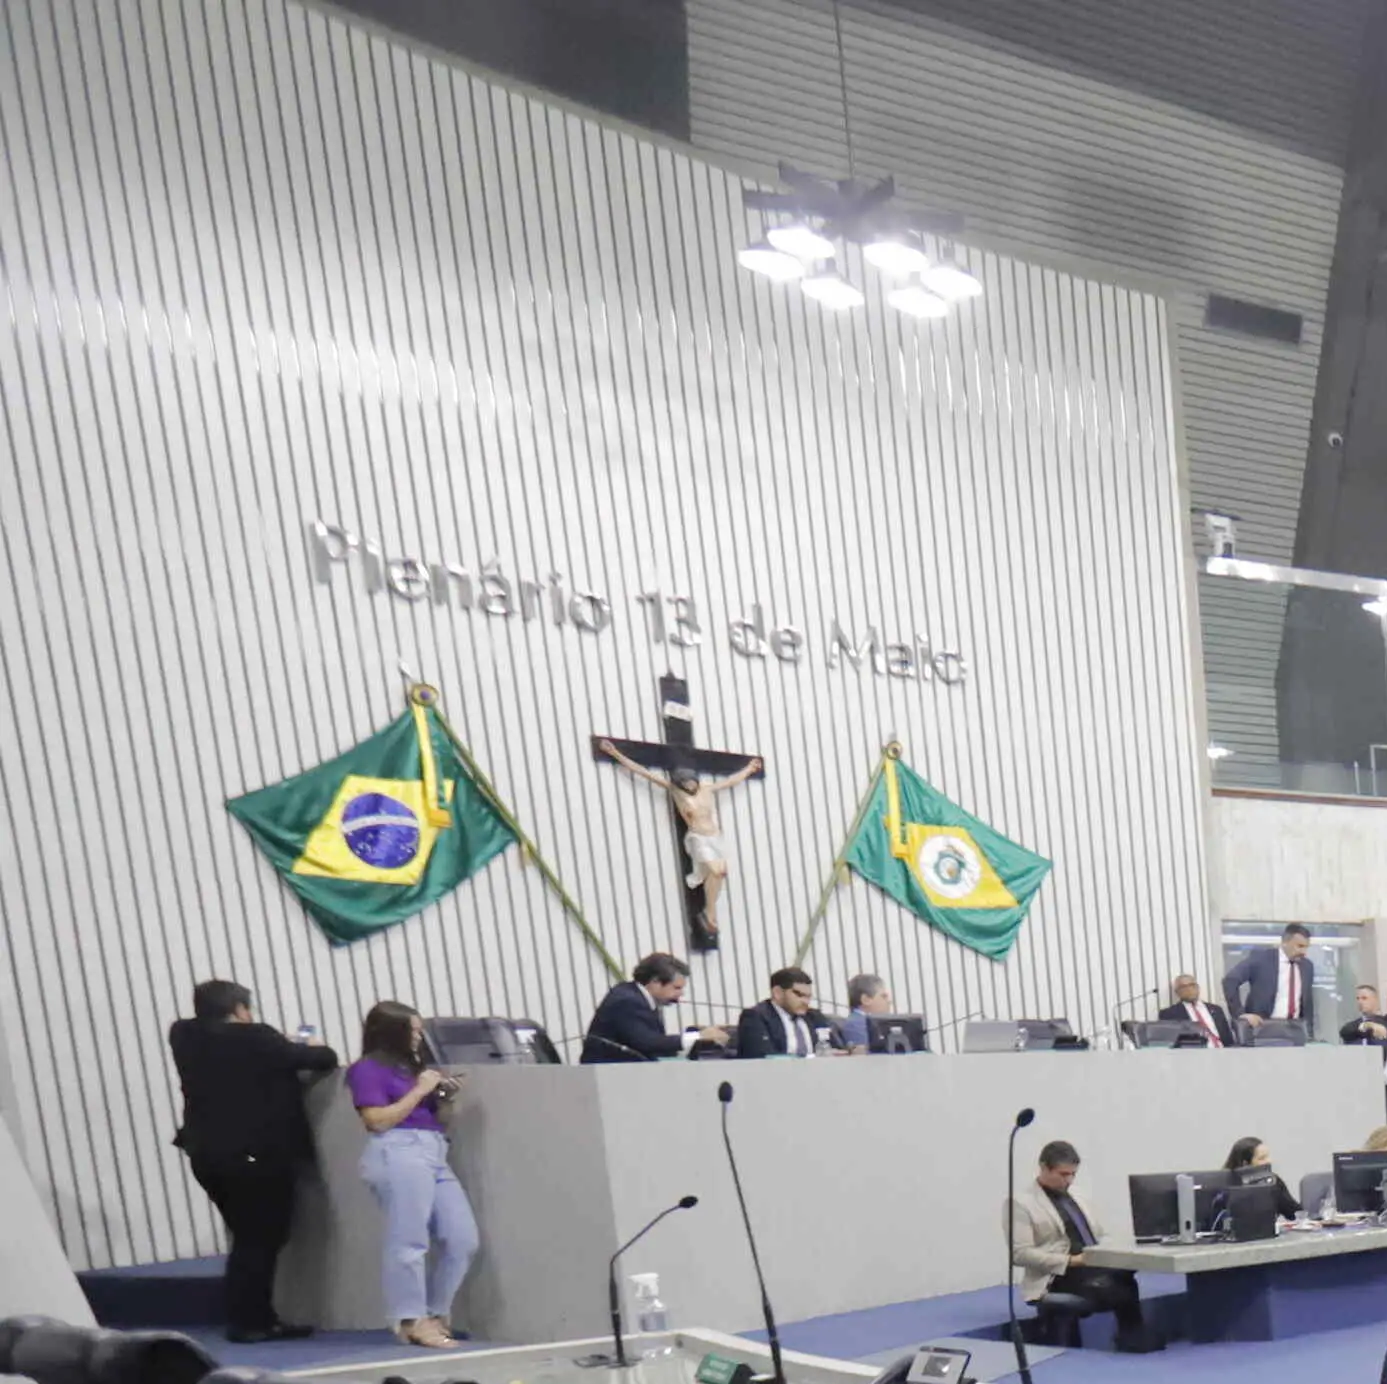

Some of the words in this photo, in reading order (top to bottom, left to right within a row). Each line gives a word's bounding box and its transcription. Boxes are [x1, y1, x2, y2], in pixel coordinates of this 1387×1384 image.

[310, 518, 611, 634] Plenário
[635, 592, 702, 648] 13
[731, 601, 802, 664] de
[827, 615, 969, 687] Maio
